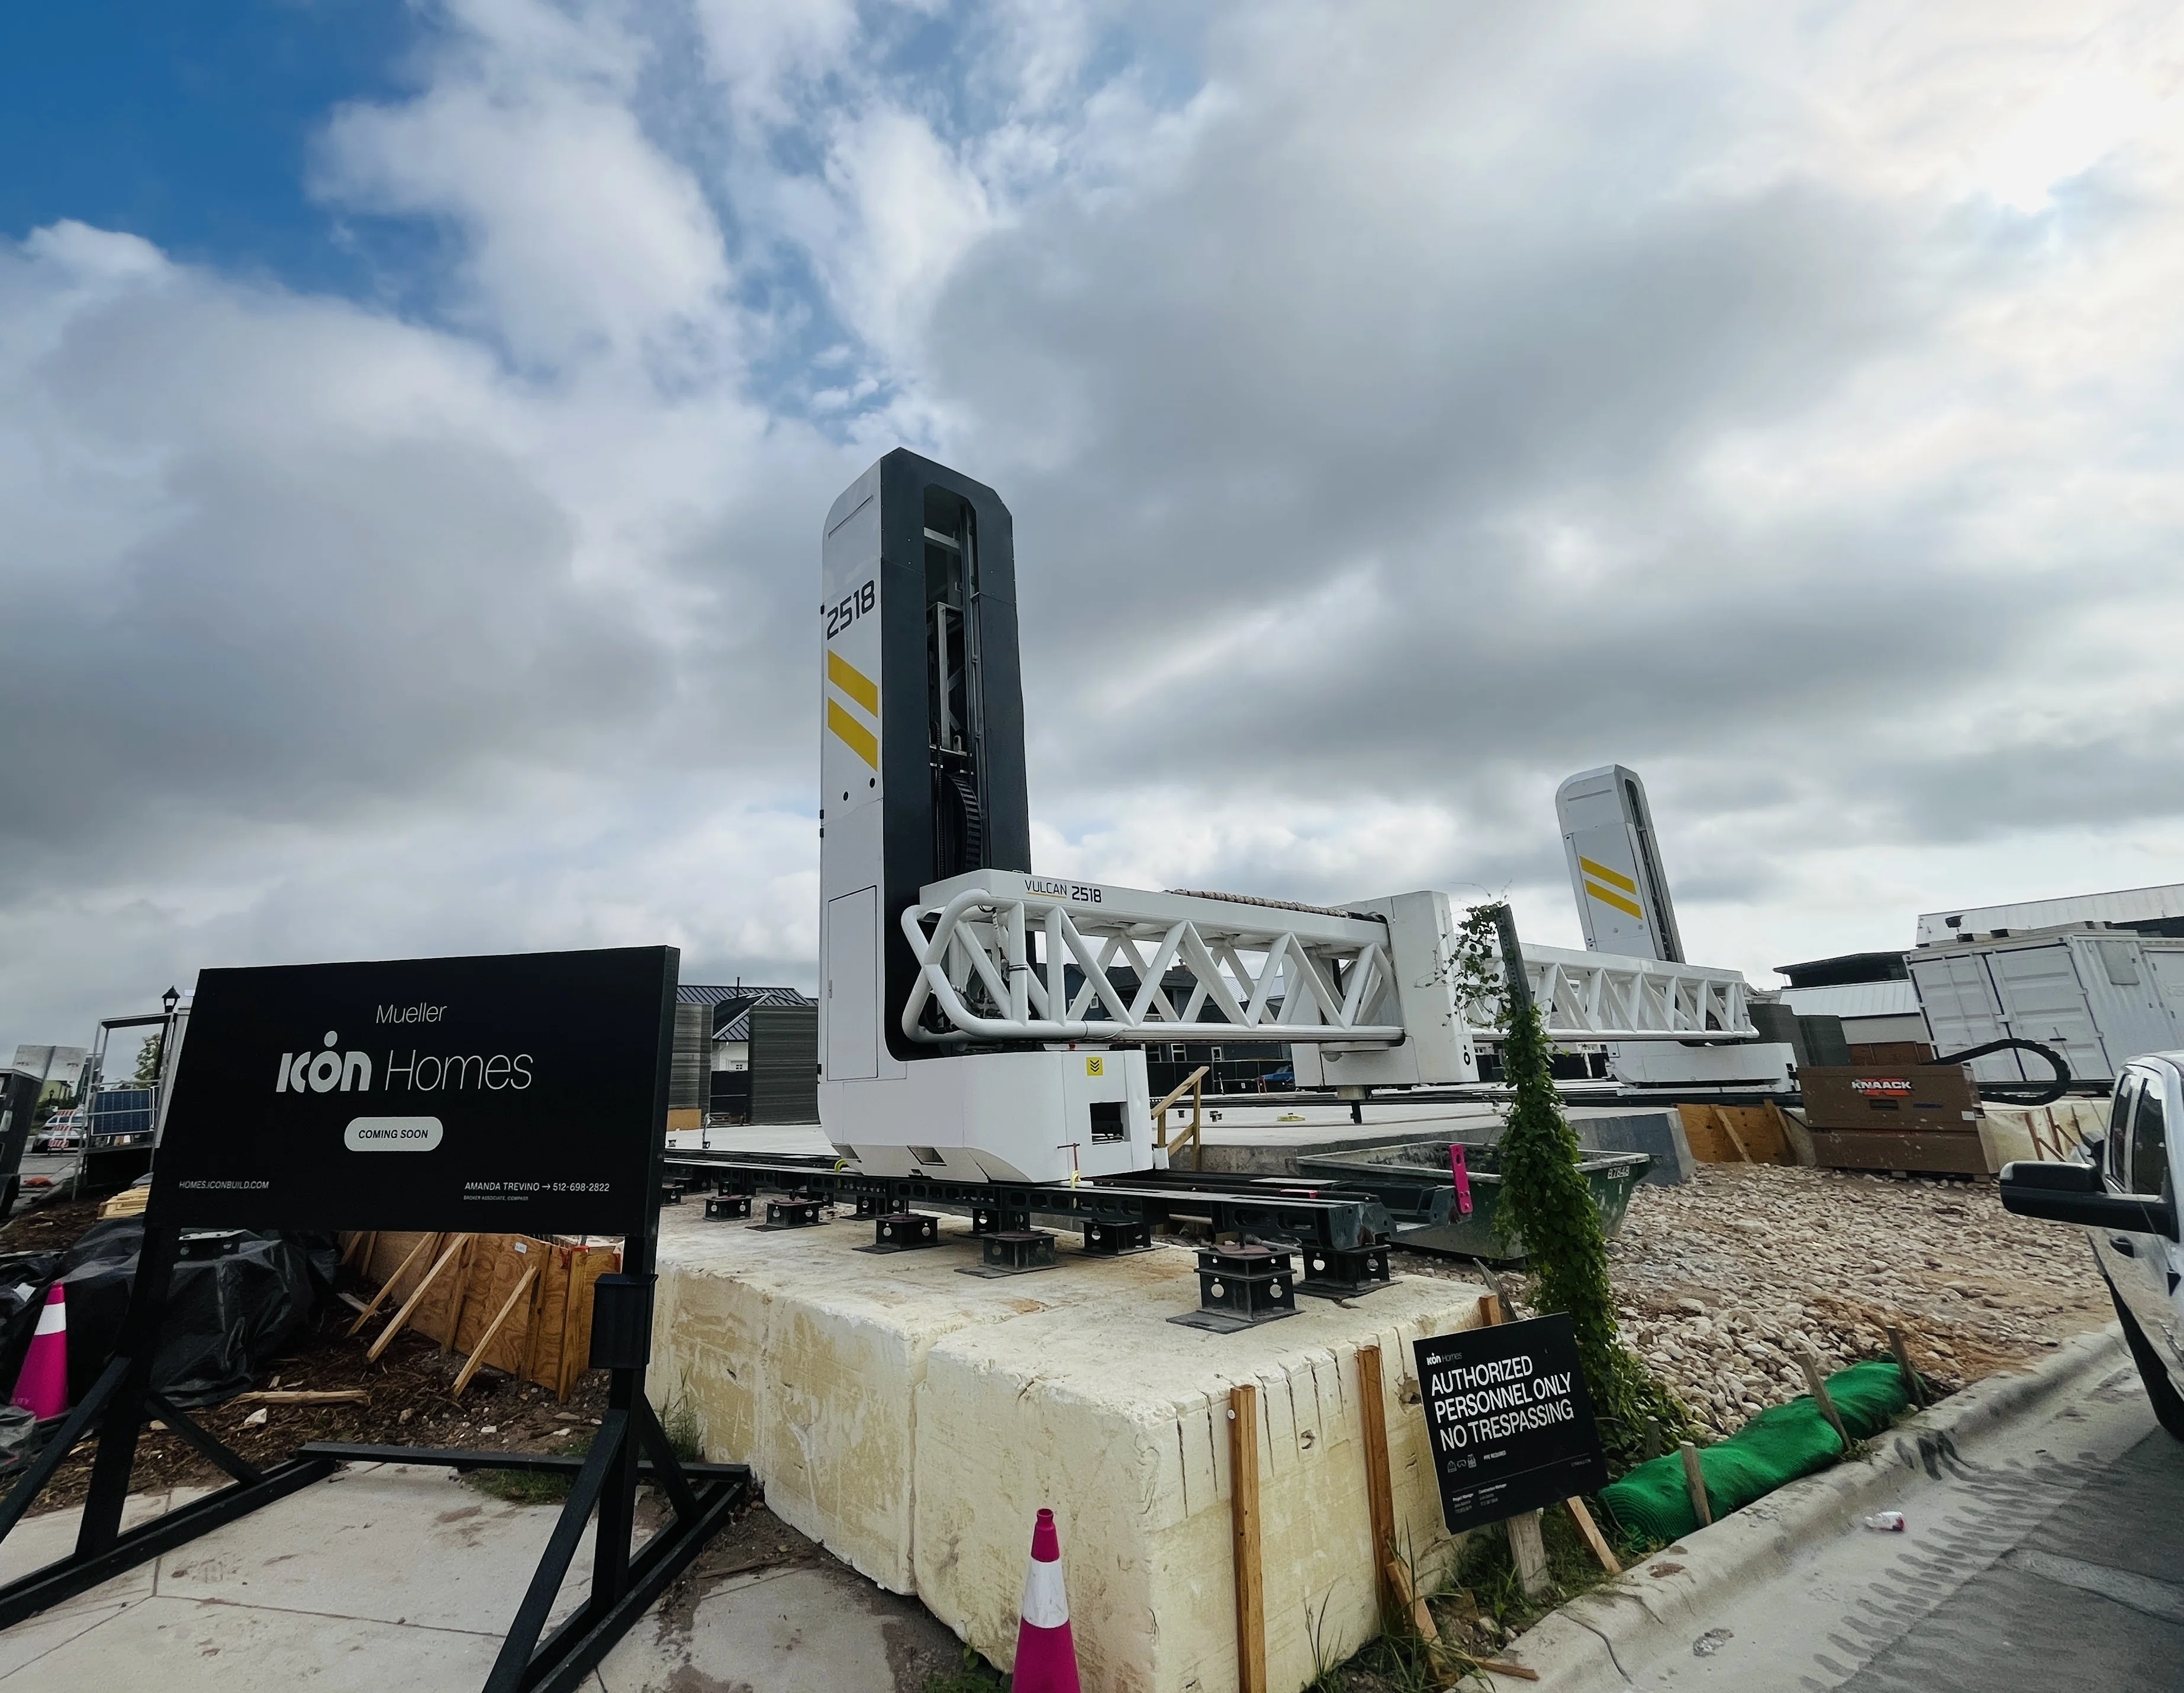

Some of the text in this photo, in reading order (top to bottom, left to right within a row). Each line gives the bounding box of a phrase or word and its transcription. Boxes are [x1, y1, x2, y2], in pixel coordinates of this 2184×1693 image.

[827, 580, 875, 640] 2518
[1025, 879, 1101, 903] VULCAN 2518
[376, 1002, 447, 1024] Mueller
[385, 1049, 533, 1091] Homes
[1851, 1081, 1912, 1089] KNAACK
[358, 1129, 429, 1139] COMING SOON
[179, 1181, 269, 1189] HOMES.ICONBUILD.COM
[465, 1182, 610, 1192] AMANDA TREVINO 512-698-2822
[1432, 1356, 1533, 1396] AUTHORIZED
[1435, 1372, 1571, 1423] PERSONNEL ONLY
[1439, 1399, 1574, 1451] NO TRESPASSING
